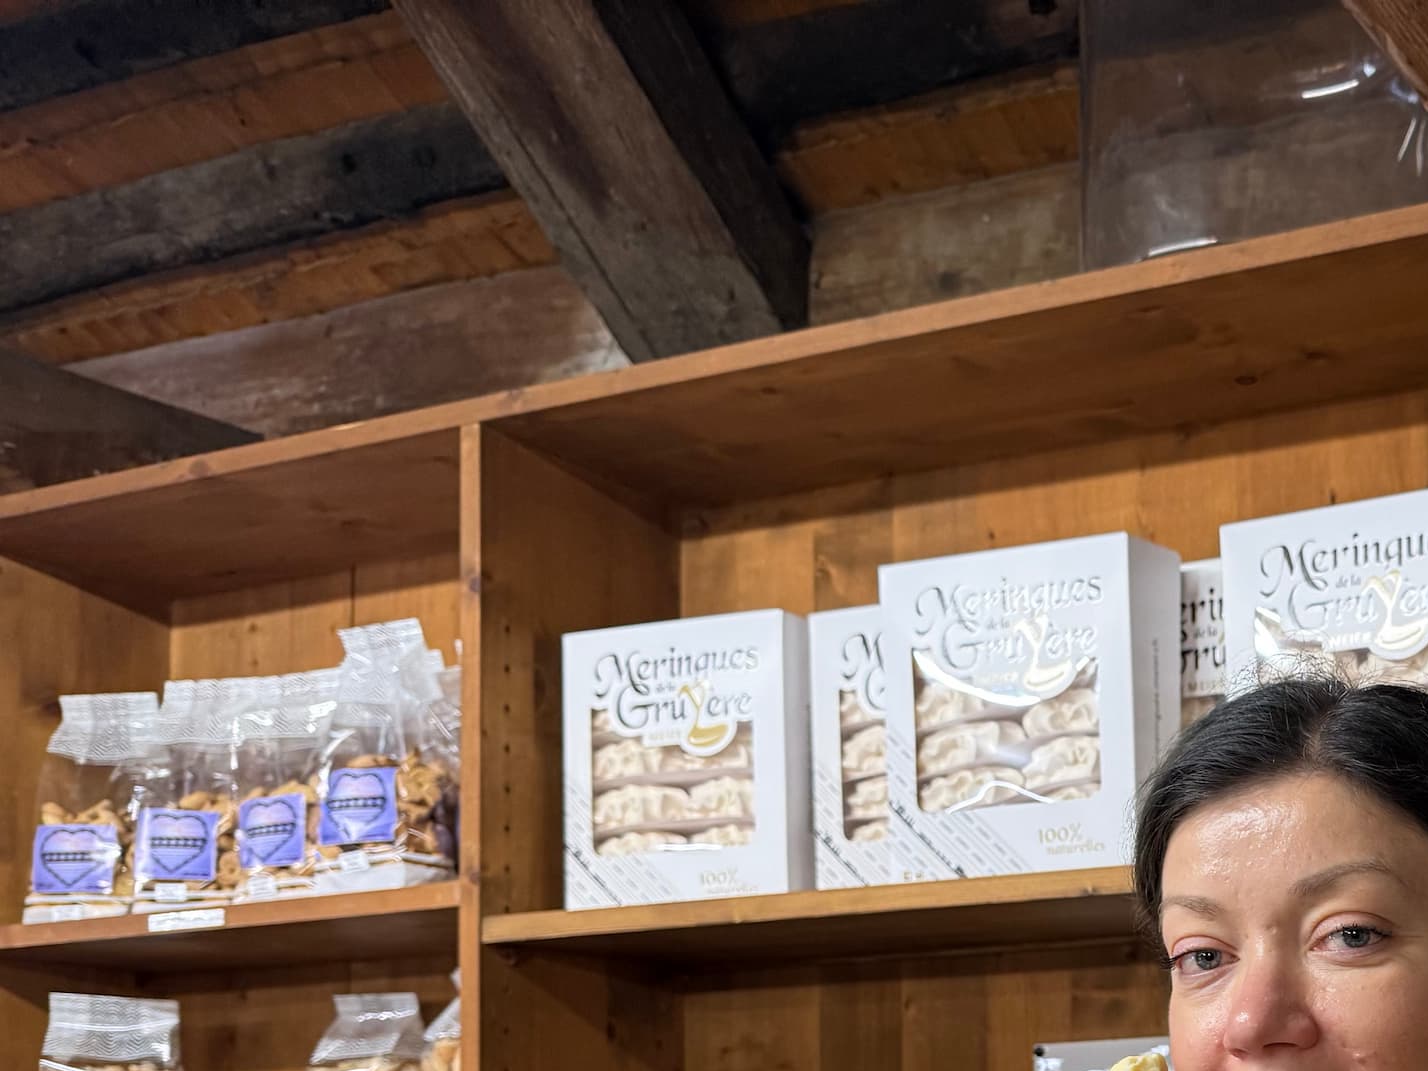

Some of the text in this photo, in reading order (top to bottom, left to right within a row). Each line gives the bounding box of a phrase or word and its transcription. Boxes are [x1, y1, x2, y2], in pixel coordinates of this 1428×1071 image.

[915, 576, 1103, 636] Meringues
[594, 646, 760, 698] Meringues
[1038, 822, 1084, 845] 100%
